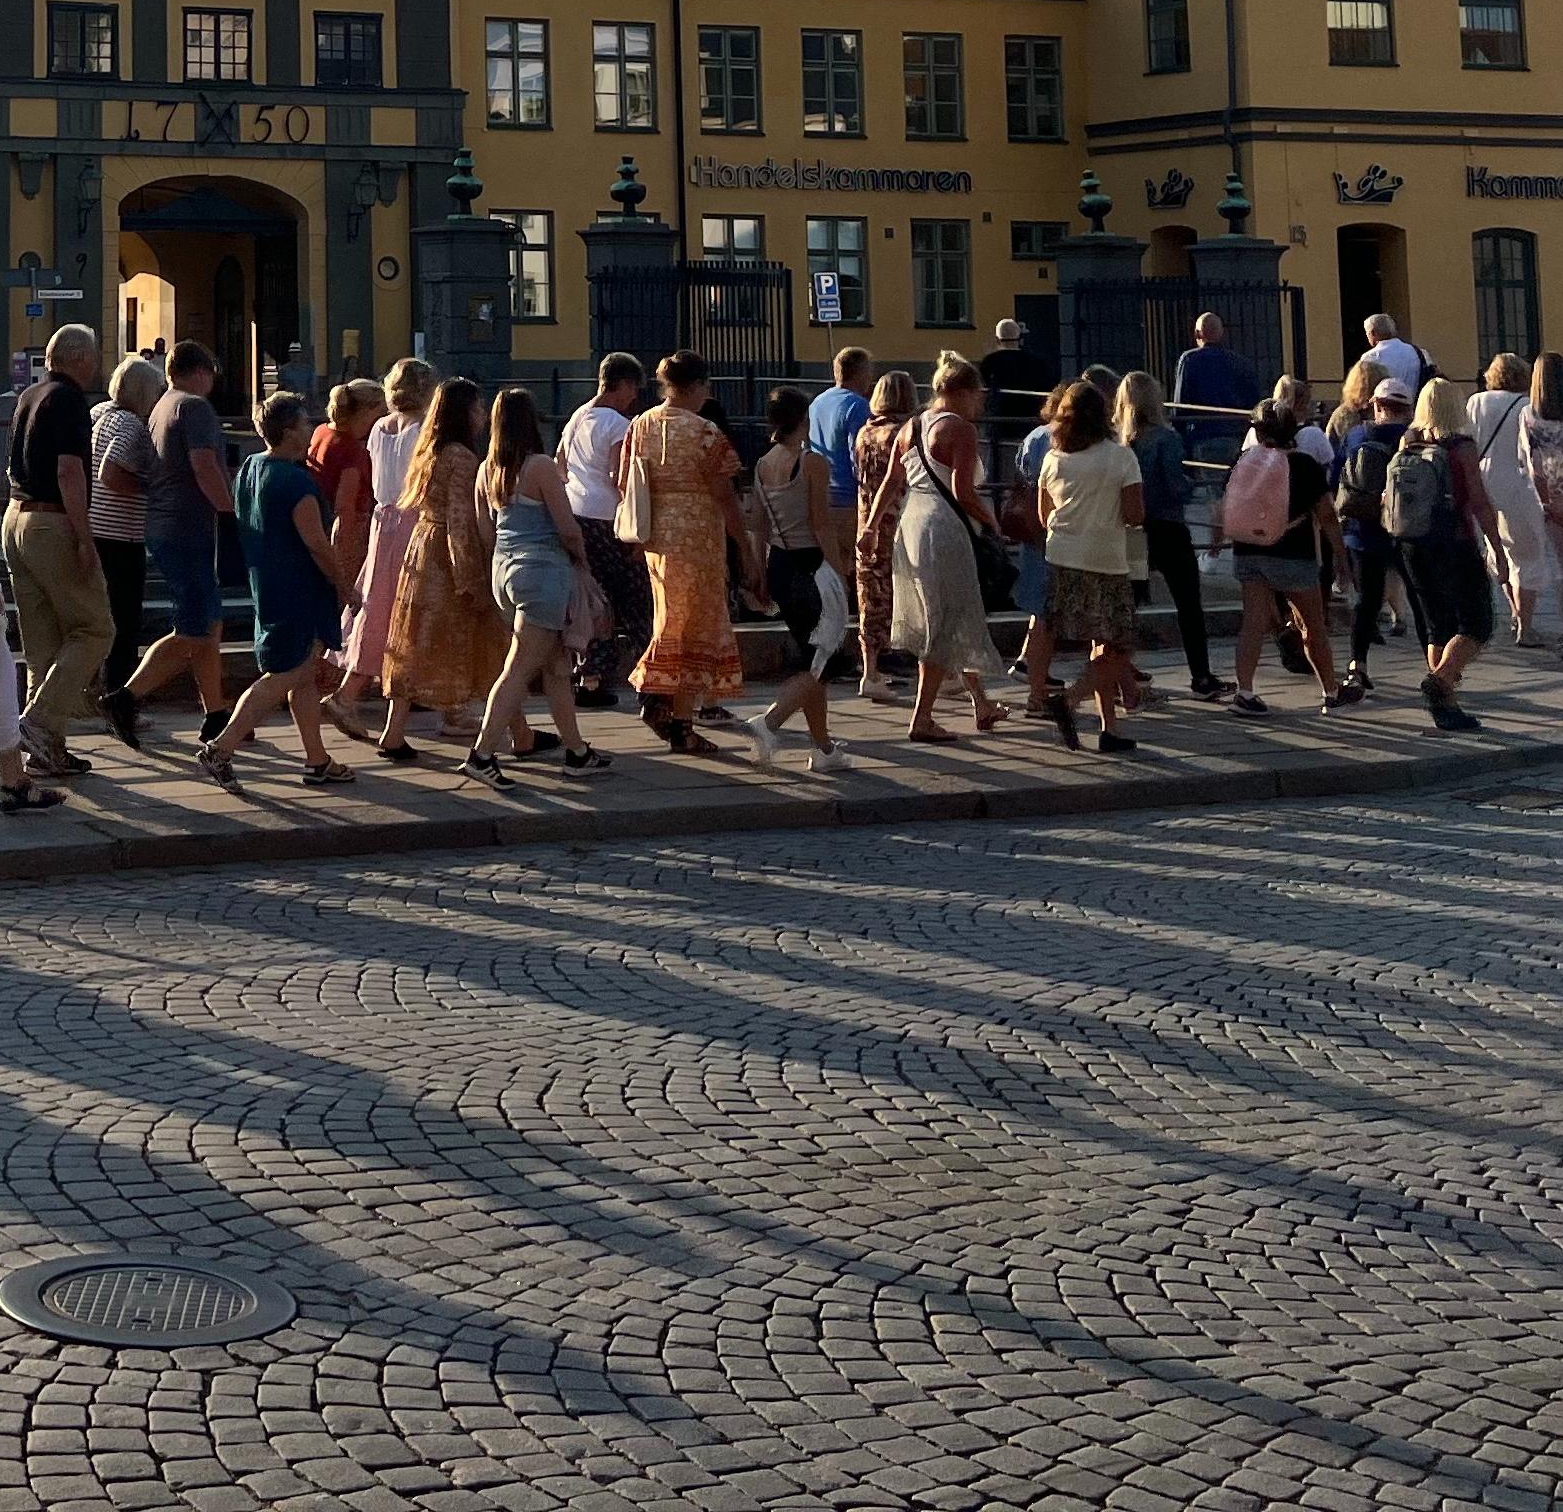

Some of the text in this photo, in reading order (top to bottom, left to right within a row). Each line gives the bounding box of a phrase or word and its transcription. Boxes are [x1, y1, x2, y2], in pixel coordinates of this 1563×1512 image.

[693, 154, 973, 193] Handelskammaren
[1465, 165, 1563, 200] Kamm
[820, 275, 834, 295] P
